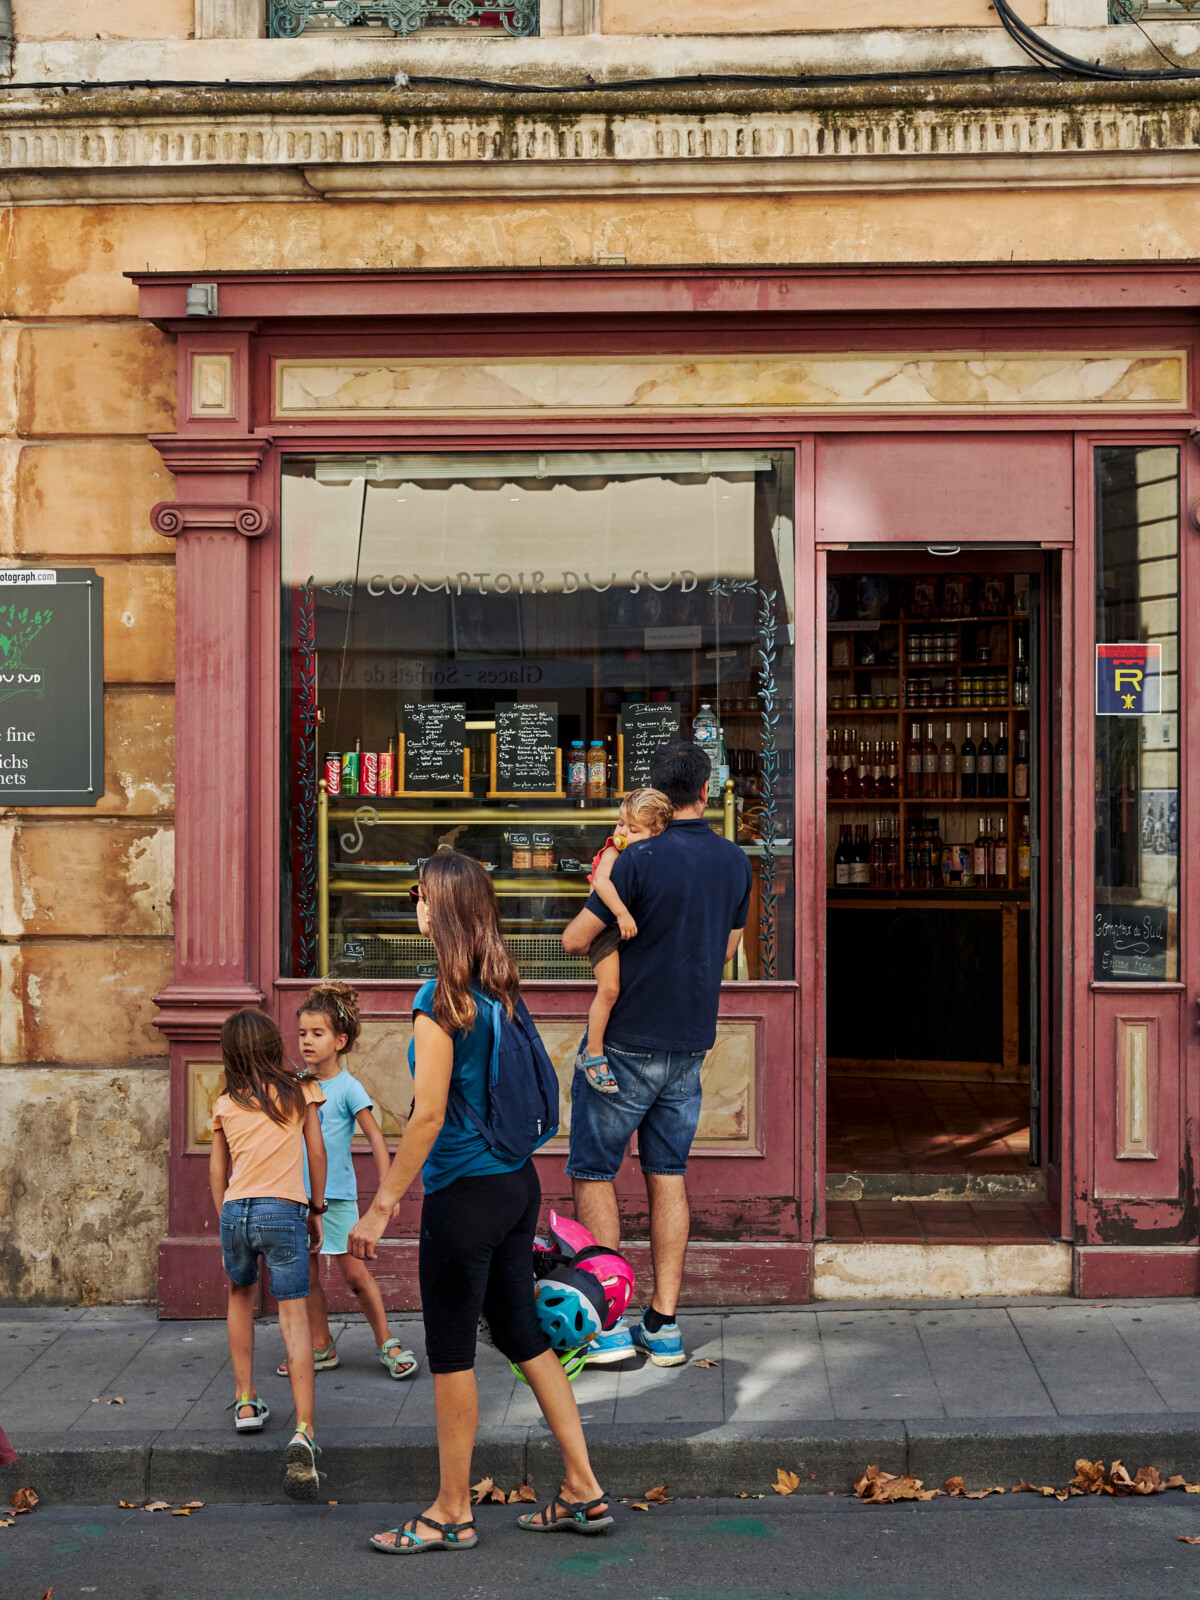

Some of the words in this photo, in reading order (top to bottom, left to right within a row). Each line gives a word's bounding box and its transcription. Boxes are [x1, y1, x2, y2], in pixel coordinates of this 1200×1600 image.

[366, 570, 549, 597] COMPTOIR
[561, 570, 617, 595] DU
[629, 569, 698, 595] SUD
[17, 673, 42, 684] SUD
[1114, 668, 1144, 692] R
[6, 726, 36, 742] fine
